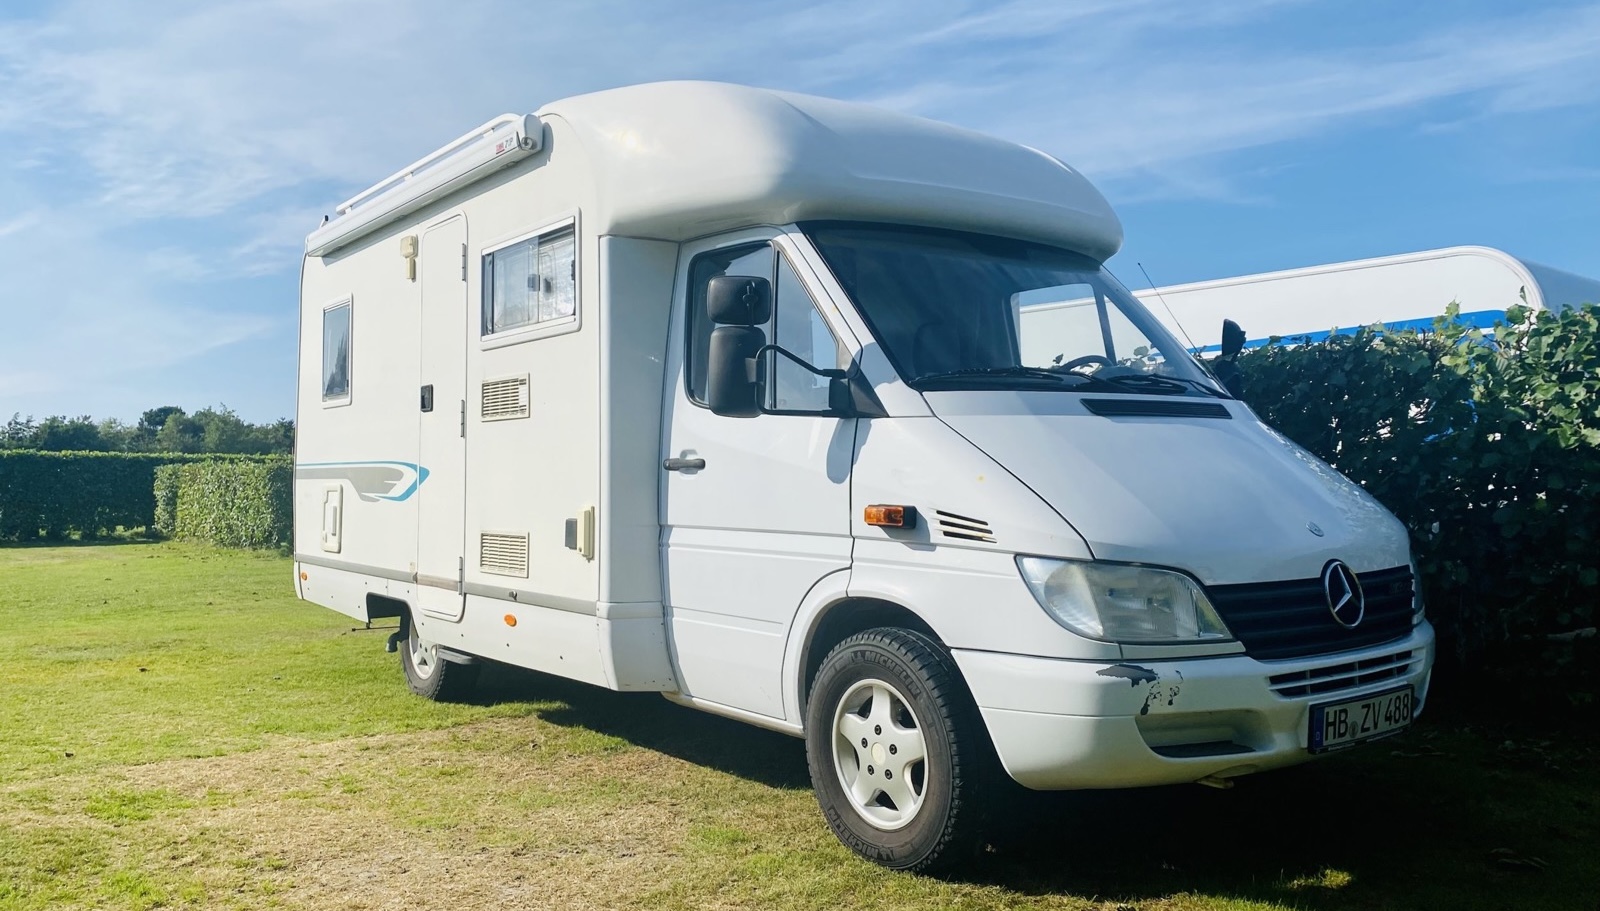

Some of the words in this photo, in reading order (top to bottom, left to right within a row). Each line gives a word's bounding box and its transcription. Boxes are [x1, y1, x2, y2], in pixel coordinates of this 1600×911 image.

[864, 650, 922, 699] MICHELIN
[1325, 708, 1349, 741] HB
[1360, 700, 1382, 733] ZV
[1384, 693, 1410, 725] 488
